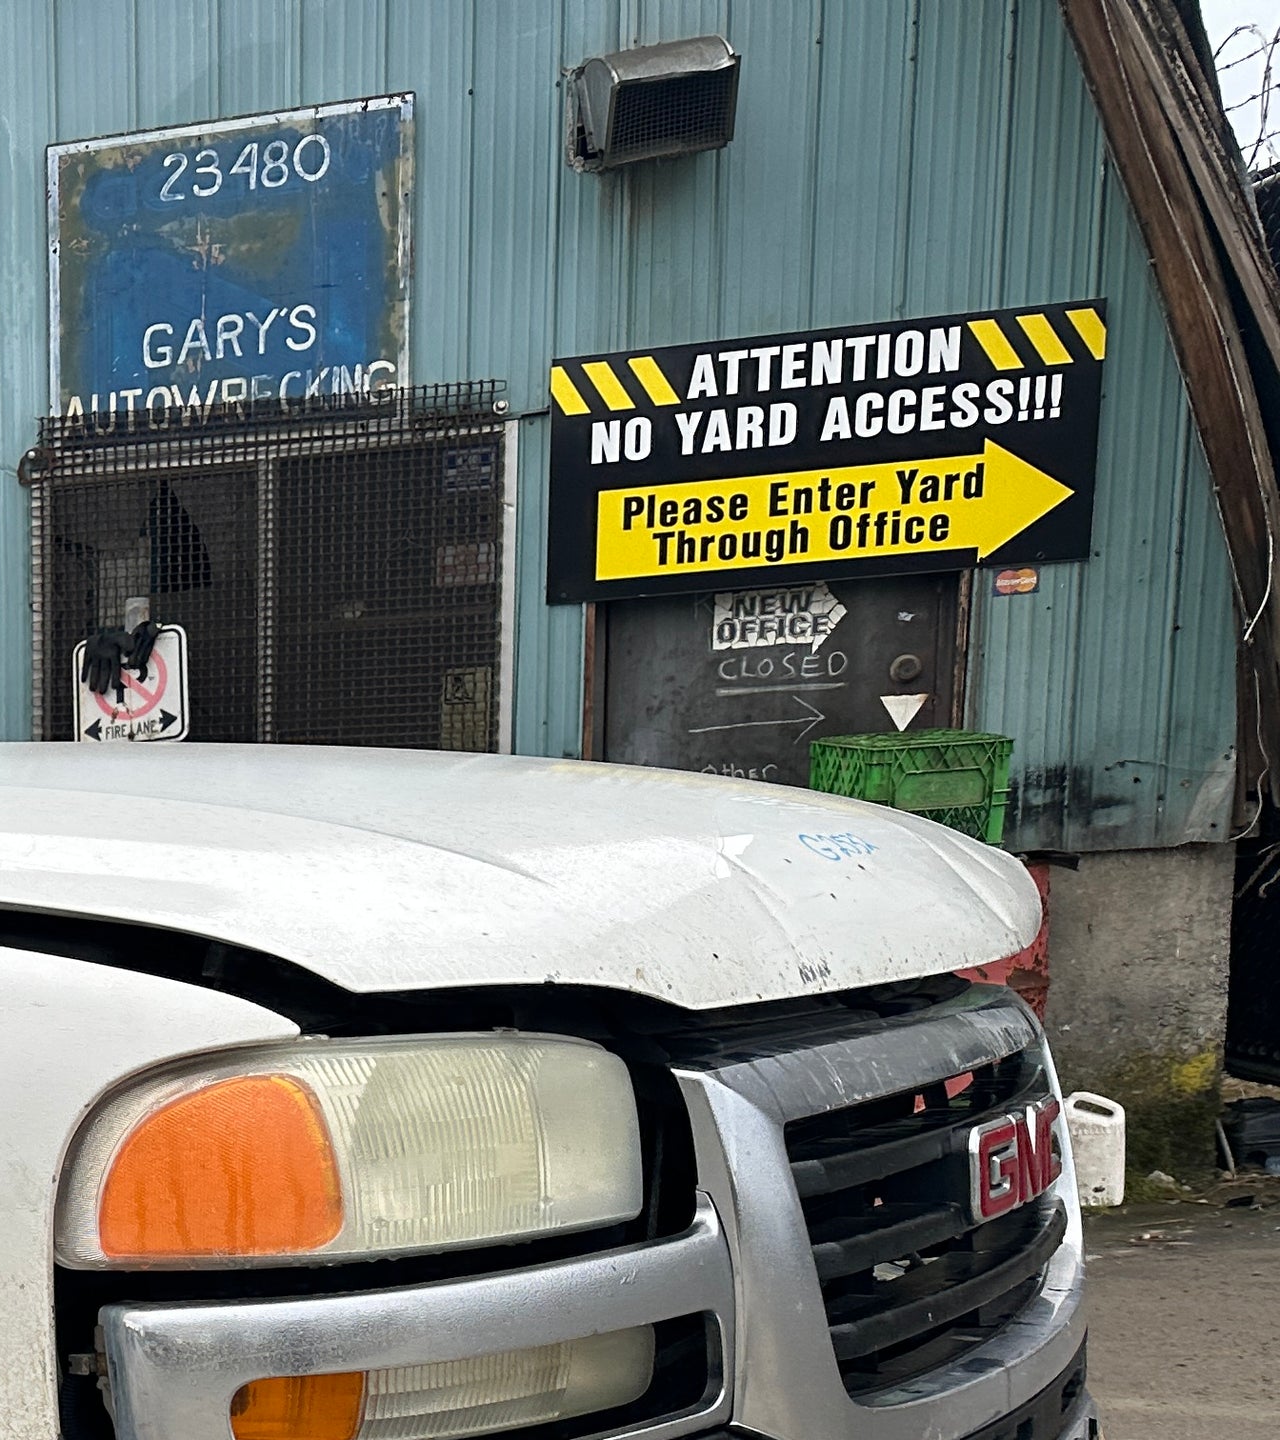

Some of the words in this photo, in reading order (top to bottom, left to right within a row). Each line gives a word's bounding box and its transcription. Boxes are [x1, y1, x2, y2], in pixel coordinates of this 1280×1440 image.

[159, 134, 331, 202] 23480
[142, 304, 317, 369] GARY'S
[686, 325, 962, 400] ATTENTION
[590, 416, 652, 465] NO
[675, 401, 798, 456] YARD
[819, 373, 1063, 443] ACCESS!!!
[622, 488, 749, 531] Please
[769, 476, 873, 518] Enter
[896, 462, 985, 502] Yard
[651, 520, 808, 566] Through
[828, 507, 950, 551] Office
[717, 614, 831, 644] OFFICE
[733, 590, 814, 618] NEW
[718, 651, 848, 680] CLOSED
[105, 724, 127, 740] FIRE
[969, 1094, 1062, 1225] GMC
